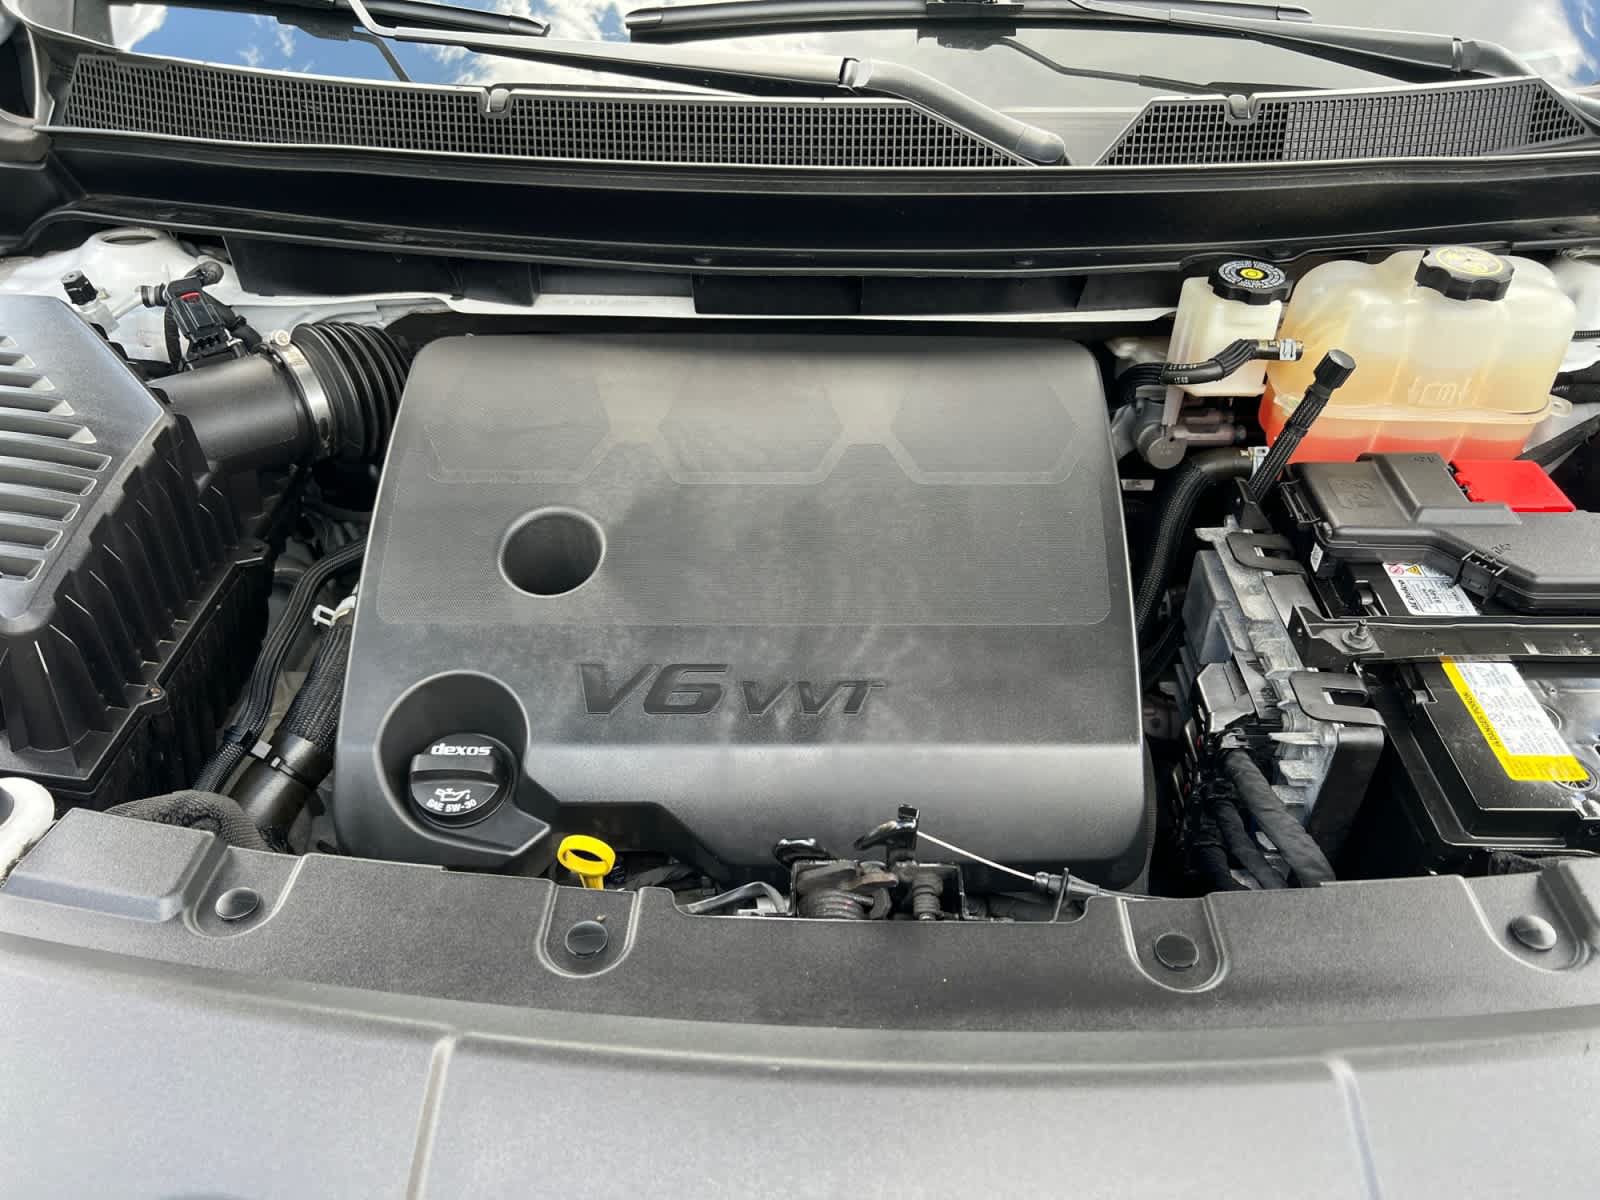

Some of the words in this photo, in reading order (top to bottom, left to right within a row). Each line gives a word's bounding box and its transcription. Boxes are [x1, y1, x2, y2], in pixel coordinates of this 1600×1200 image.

[578, 663, 731, 715] V6
[742, 680, 886, 715] VVT
[430, 743, 493, 756] dexos
[426, 798, 445, 811] SAE
[445, 798, 477, 812] 5W-30
